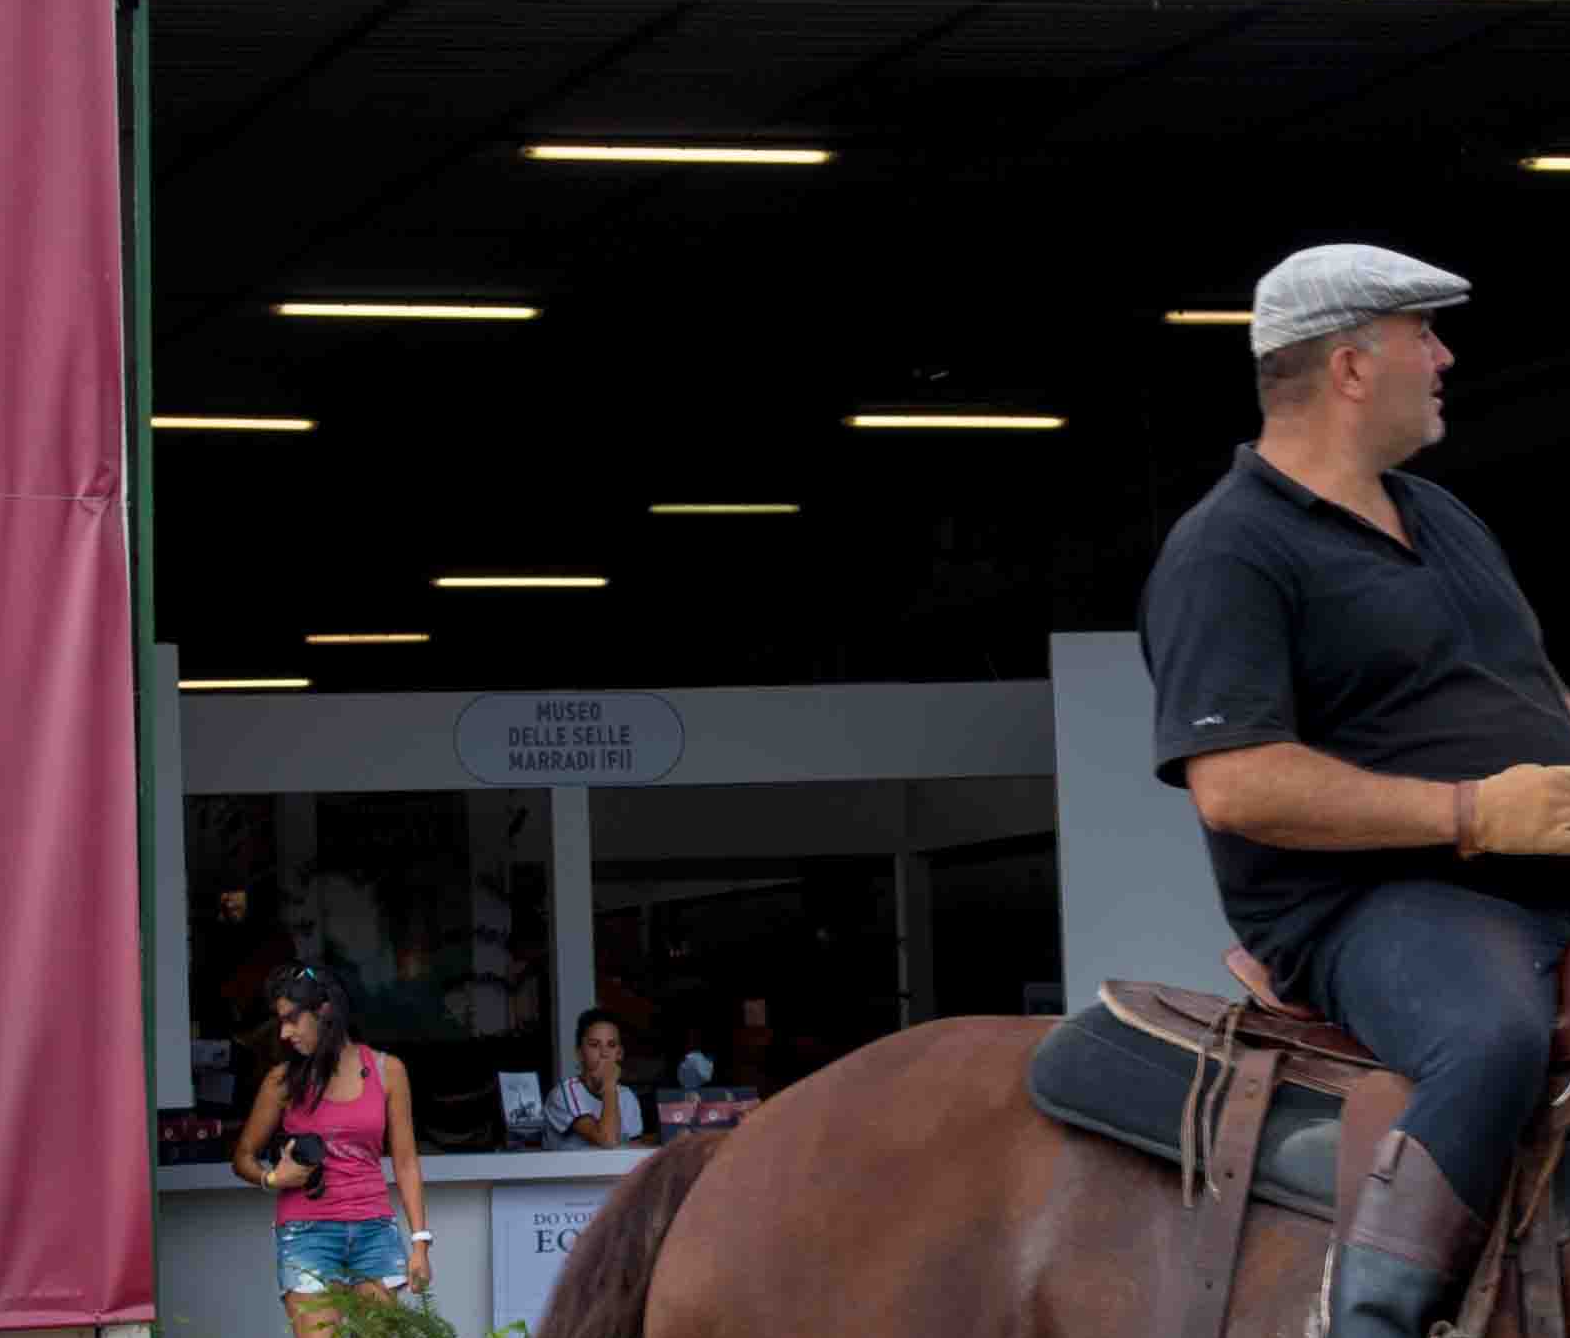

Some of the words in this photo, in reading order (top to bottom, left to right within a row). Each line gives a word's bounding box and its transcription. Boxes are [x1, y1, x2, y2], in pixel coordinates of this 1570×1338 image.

[536, 701, 602, 722] MUSEO
[508, 726, 566, 747] DELLE
[572, 725, 632, 746] SELLE
[508, 749, 596, 772] MARRADI
[564, 1213, 591, 1224] YO
